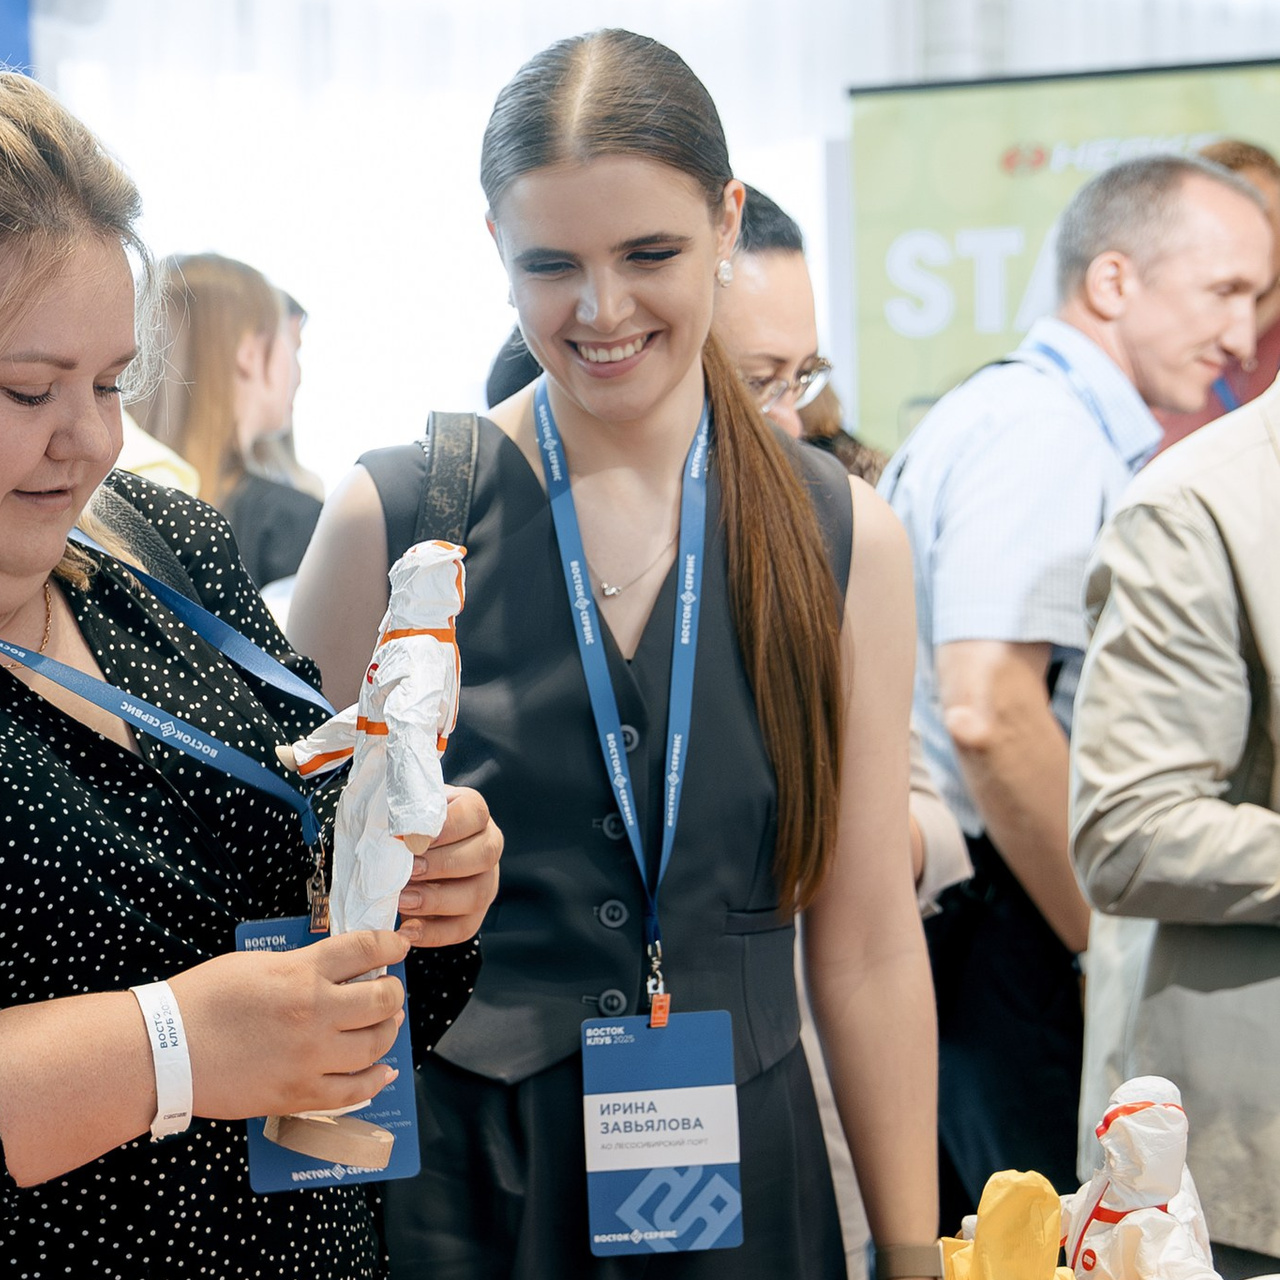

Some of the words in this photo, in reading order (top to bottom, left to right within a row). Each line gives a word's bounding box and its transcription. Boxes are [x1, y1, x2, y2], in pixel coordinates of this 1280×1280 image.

[538, 404, 552, 440] ВОСТОК
[570, 560, 585, 603] ВОСТОК
[579, 610, 595, 645] СЕРВИС
[681, 604, 692, 645] ВОСТОК
[120, 701, 162, 728] СЕРВИС
[174, 729, 219, 759] ВОСТОК
[606, 732, 622, 775] ВОСТОК
[244, 934, 287, 949] ВОСТОК
[586, 1026, 625, 1038] ВОСТОК
[599, 1101, 658, 1117] ИРИНА
[599, 1117, 705, 1135] ЗАВЬЯЛОВА
[291, 1168, 332, 1181] ВОСТОК
